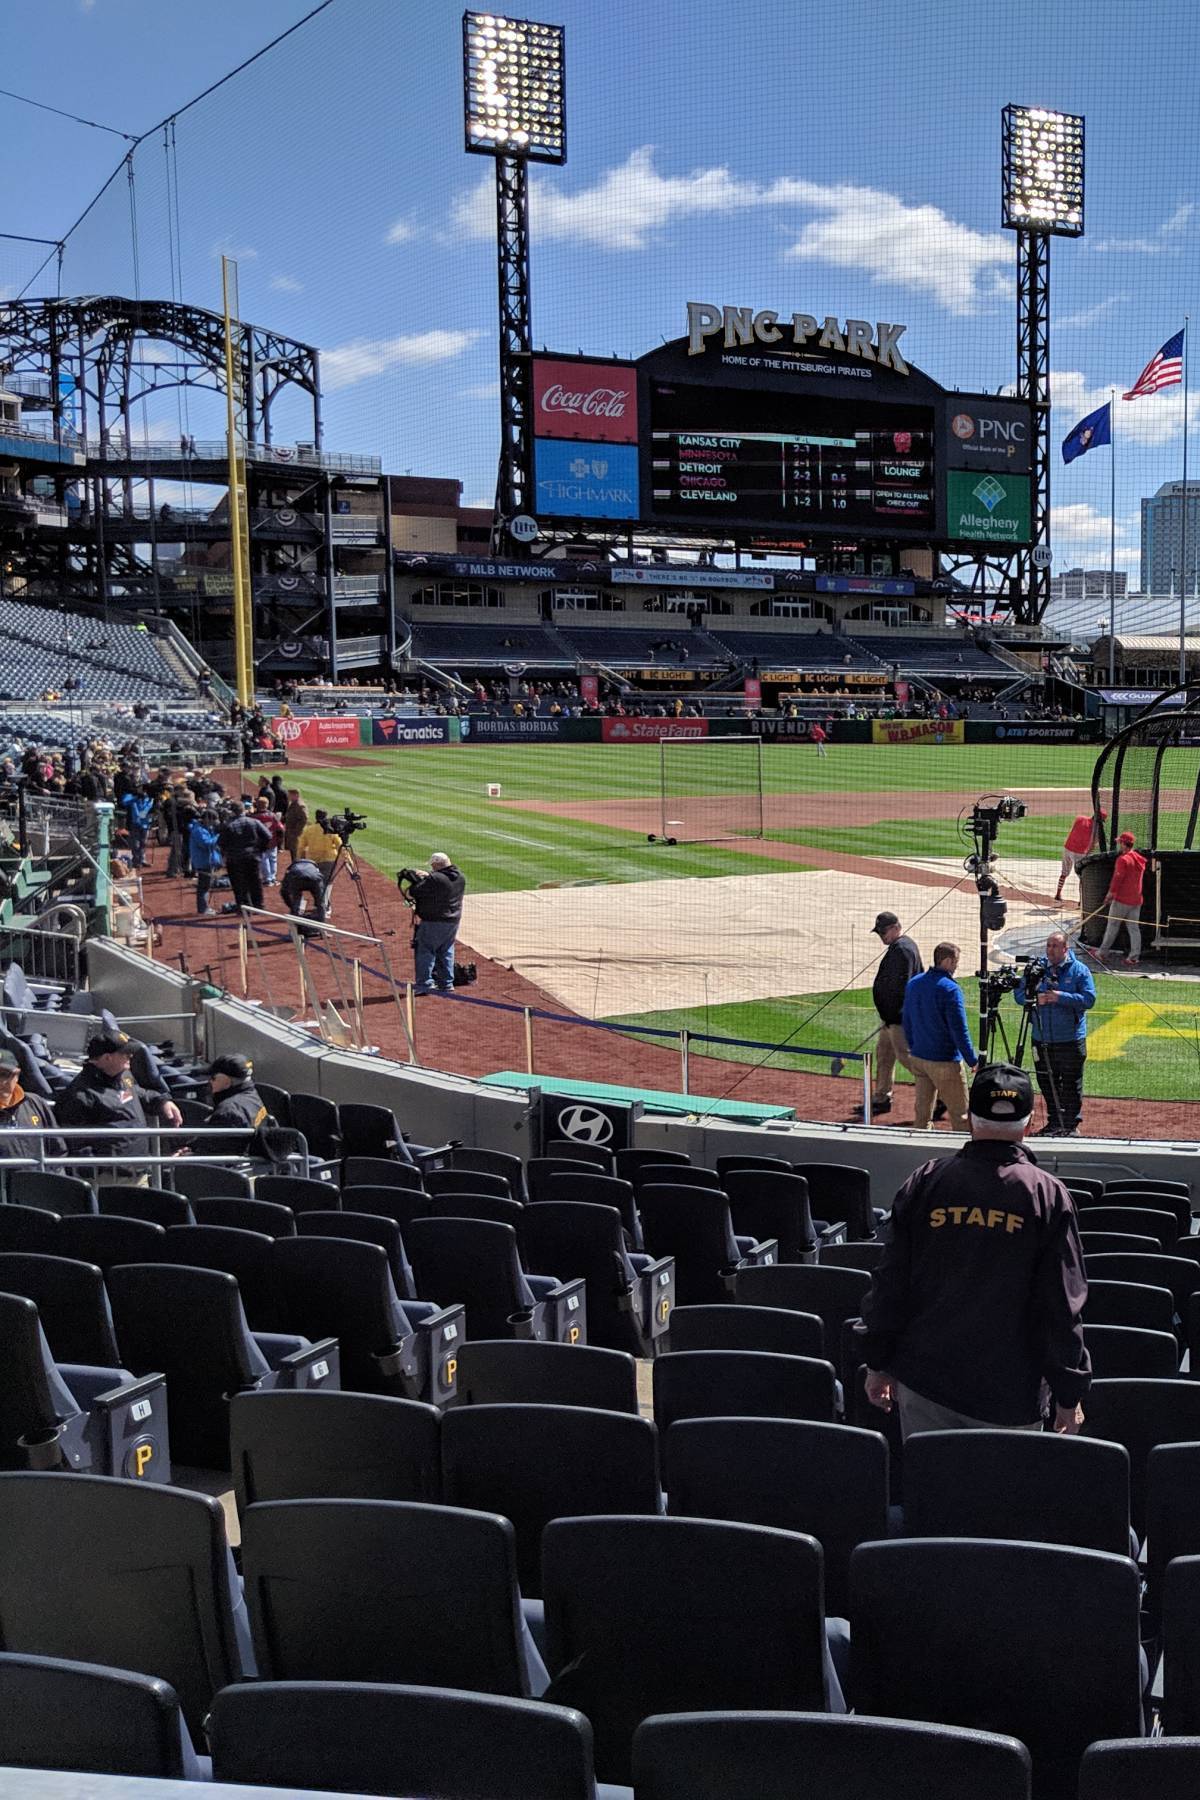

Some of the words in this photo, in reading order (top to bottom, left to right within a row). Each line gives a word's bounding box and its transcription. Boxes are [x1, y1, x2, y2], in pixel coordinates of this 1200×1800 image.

[686, 301, 783, 356] PNC
[792, 312, 910, 376] PARK
[721, 354, 748, 366] HOME
[749, 356, 761, 367] OF
[763, 358, 781, 370] THE
[781, 359, 836, 375] PITTSBURGH
[837, 365, 872, 379] PIRATES
[978, 418, 1025, 442] PNC
[678, 435, 718, 447] KANSAS
[720, 437, 741, 449] CITY
[678, 449, 738, 461] MINNESOTA
[679, 462, 722, 474] DETROIT
[884, 466, 921, 478] LOUNGE
[679, 475, 727, 488] CHICAGO
[793, 471, 811, 481] 2-2
[548, 482, 633, 504] HIGHMARK
[679, 490, 738, 502] CLEVELAND
[876, 490, 893, 498] OPEN
[893, 490, 902, 499] TO
[902, 491, 913, 499] ALL
[793, 496, 811, 507] 1-2
[832, 499, 847, 509] 1.0
[513, 520, 537, 535] Lite
[959, 514, 1020, 531] Allegheny
[959, 529, 985, 539] Health
[986, 530, 1019, 541] Network
[1034, 550, 1051, 562] Lite
[469, 563, 496, 575] MLB
[498, 564, 556, 578] NETWORK
[661, 670, 687, 680] LIGHT
[700, 671, 710, 680] IC
[770, 673, 794, 682] LIGHT
[804, 674, 815, 682] IC
[816, 674, 841, 683] LIGHT
[852, 674, 862, 684] IC
[863, 675, 886, 685] LIGHT
[397, 723, 444, 741] Fanatics
[476, 720, 517, 732] BORDAS
[520, 721, 560, 732] BORDAS
[751, 720, 833, 735] RIVENDAE
[1006, 728, 1028, 737] AT&T
[1027, 728, 1075, 738] SPORTSNET
[31, 1115, 40, 1127] P
[928, 1206, 1025, 1234] STAFF
[661, 1299, 670, 1321] P
[570, 1327, 579, 1345] P
[446, 1359, 457, 1385] P
[138, 1404, 146, 1416] H
[136, 1444, 153, 1477] P
